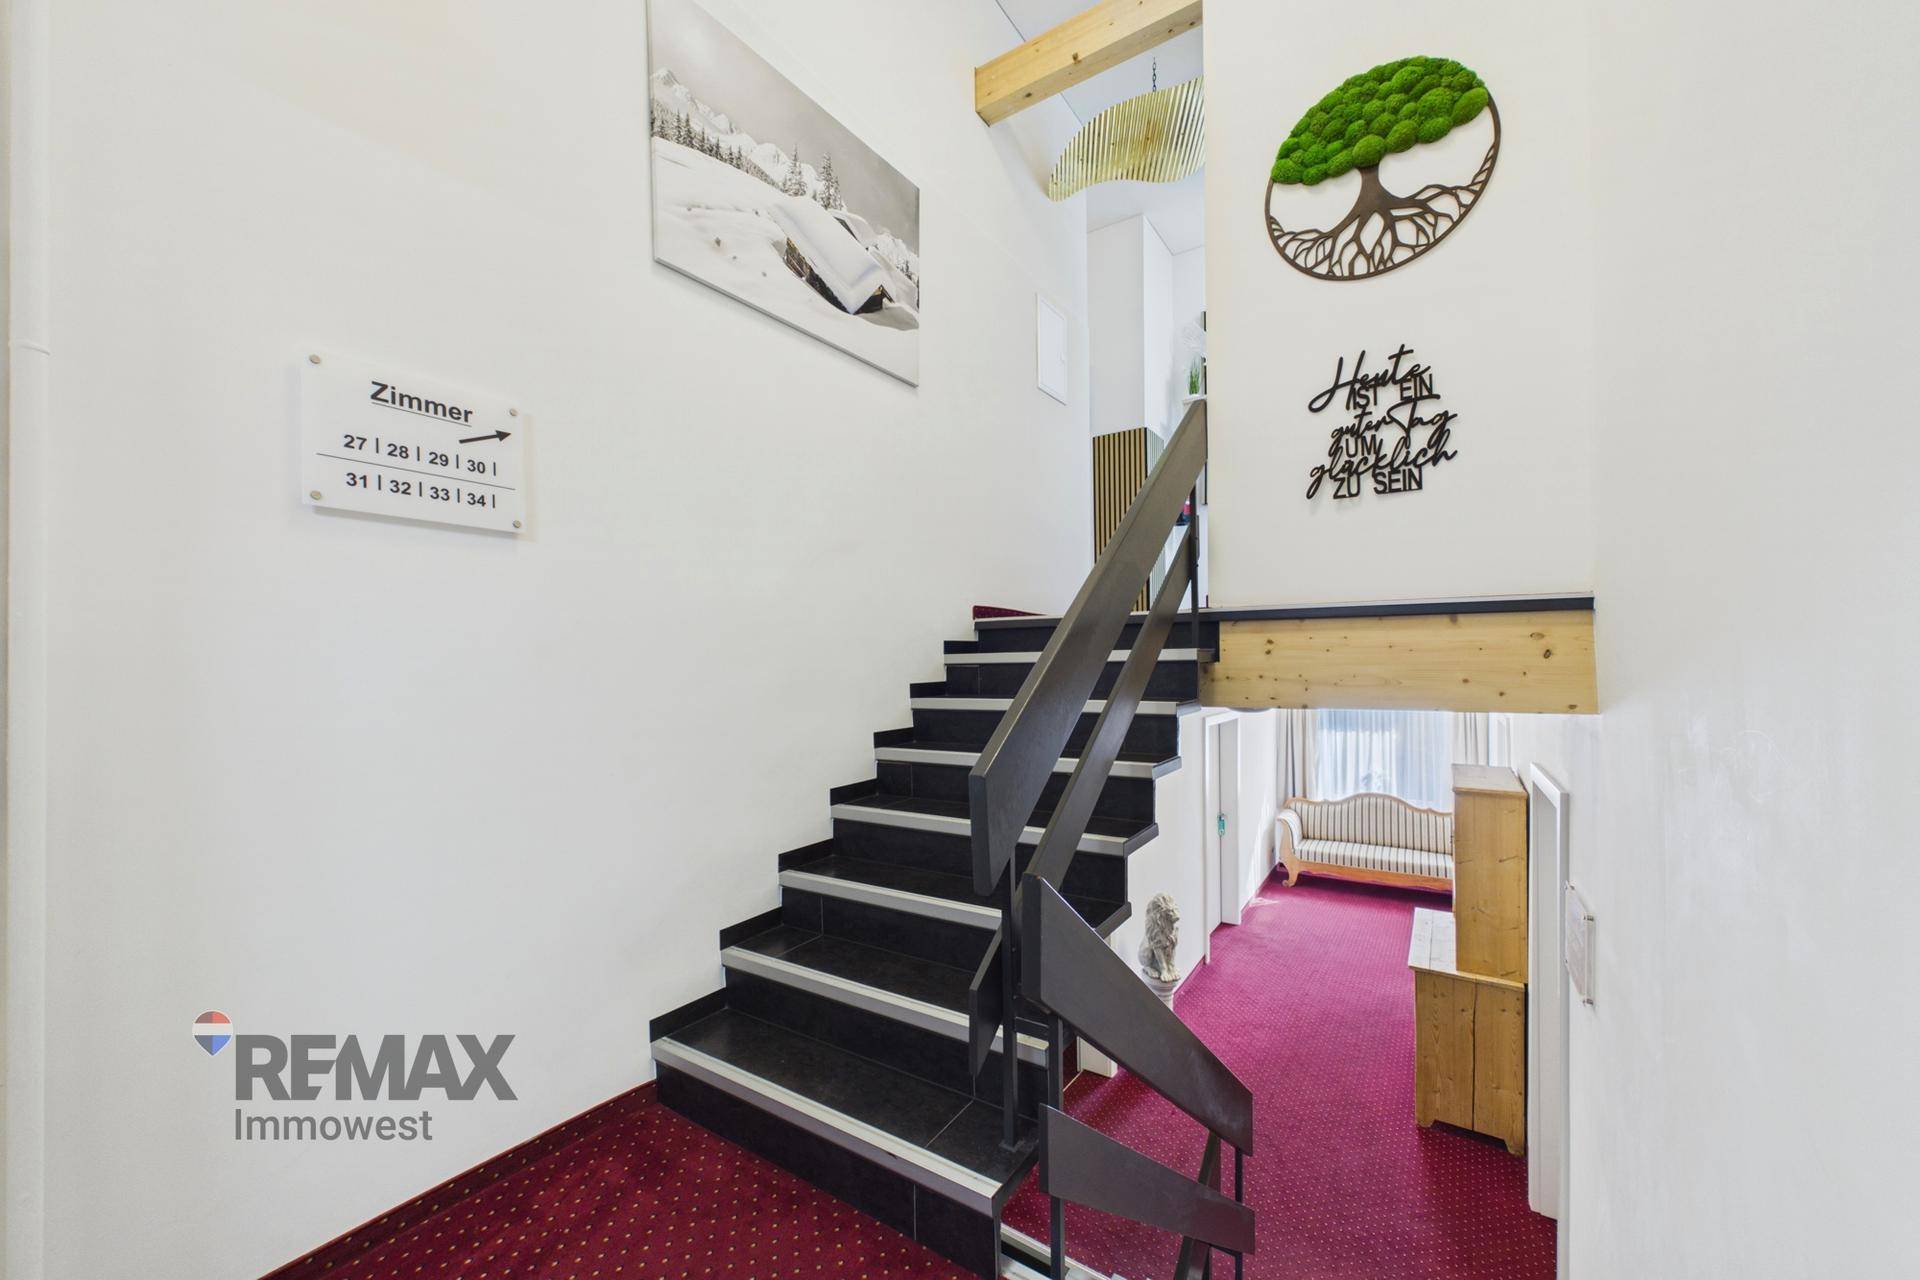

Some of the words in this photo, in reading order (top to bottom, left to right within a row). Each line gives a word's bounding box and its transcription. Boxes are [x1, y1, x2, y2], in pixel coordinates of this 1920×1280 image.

[1308, 344, 1431, 413] Heute
[1352, 385, 1378, 409] IST
[1400, 373, 1434, 401] EIN
[370, 380, 473, 423] Zimmer
[1386, 394, 1458, 449] Tag
[343, 434, 367, 450] 27
[387, 443, 409, 459] 28
[428, 451, 449, 467] 29
[467, 459, 486, 474] 30
[1346, 434, 1378, 458] UM
[346, 472, 368, 488] 31
[389, 480, 411, 496] 32
[430, 486, 450, 501] 33
[467, 493, 486, 507] 34
[1333, 475, 1360, 499] ZU
[1373, 466, 1423, 494] SEIN
